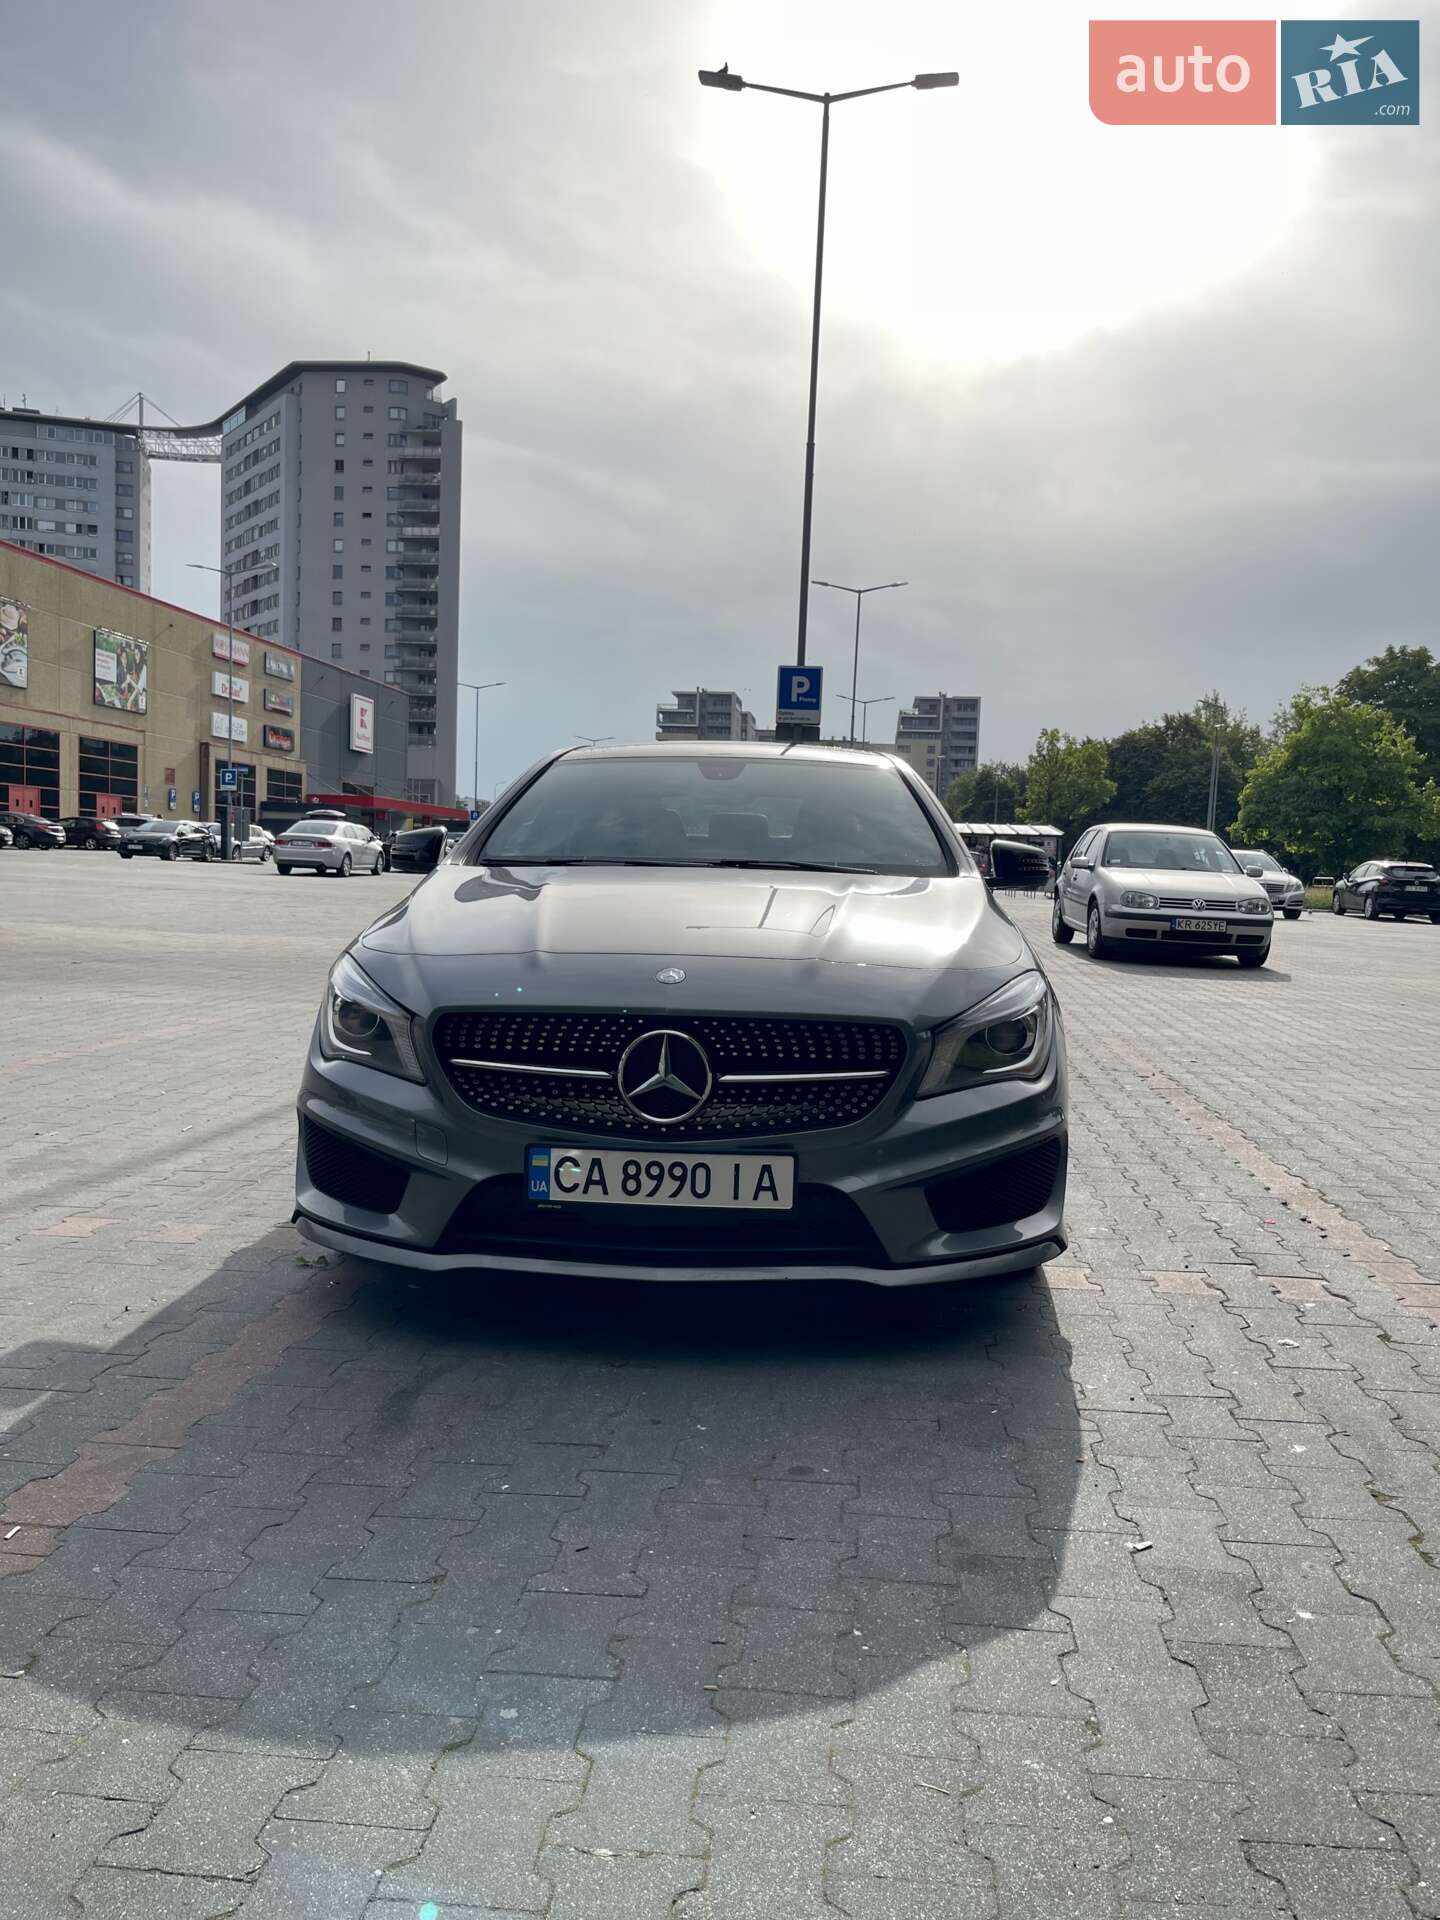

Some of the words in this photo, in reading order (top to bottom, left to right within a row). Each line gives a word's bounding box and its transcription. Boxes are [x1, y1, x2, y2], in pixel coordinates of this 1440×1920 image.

[791, 675, 810, 702] P
[1177, 919, 1192, 929] KR
[531, 1180, 548, 1193] UA
[554, 1156, 609, 1196] CA
[621, 1159, 712, 1199] 8990
